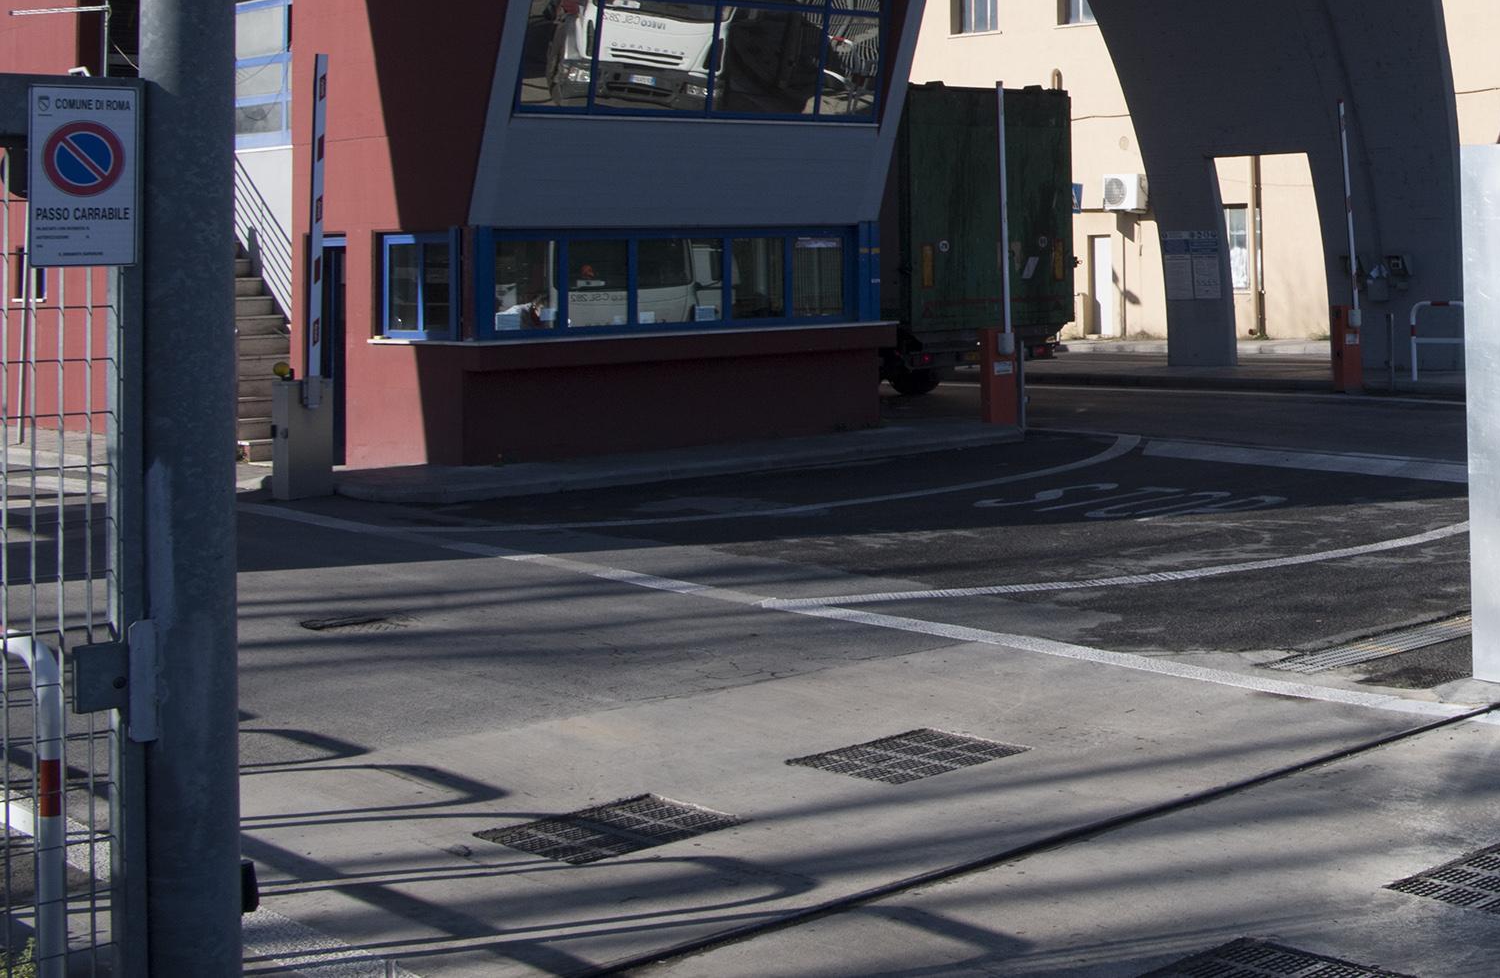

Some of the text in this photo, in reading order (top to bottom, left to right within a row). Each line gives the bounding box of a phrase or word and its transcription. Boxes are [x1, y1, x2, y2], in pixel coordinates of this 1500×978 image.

[55, 97, 131, 111] COMUNE DI ROMA
[35, 207, 130, 221] PASSO CARRABILE
[973, 482, 1288, 522] STOP
